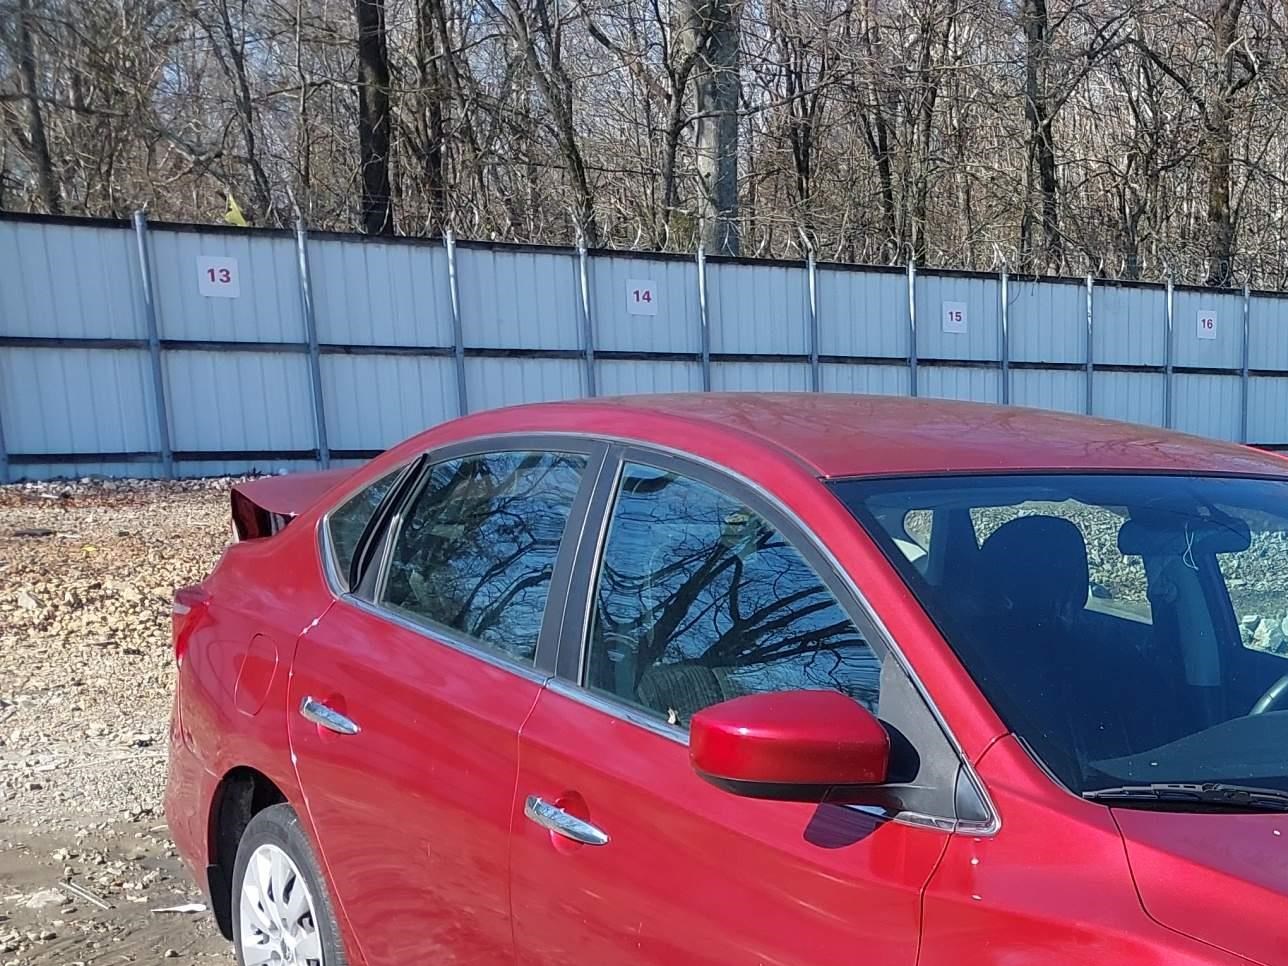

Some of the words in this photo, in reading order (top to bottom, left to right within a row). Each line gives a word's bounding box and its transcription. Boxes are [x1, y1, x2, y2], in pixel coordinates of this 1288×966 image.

[207, 268, 232, 283] 13
[633, 289, 652, 303] 14
[948, 311, 962, 322] 15
[1201, 318, 1213, 329] 16
